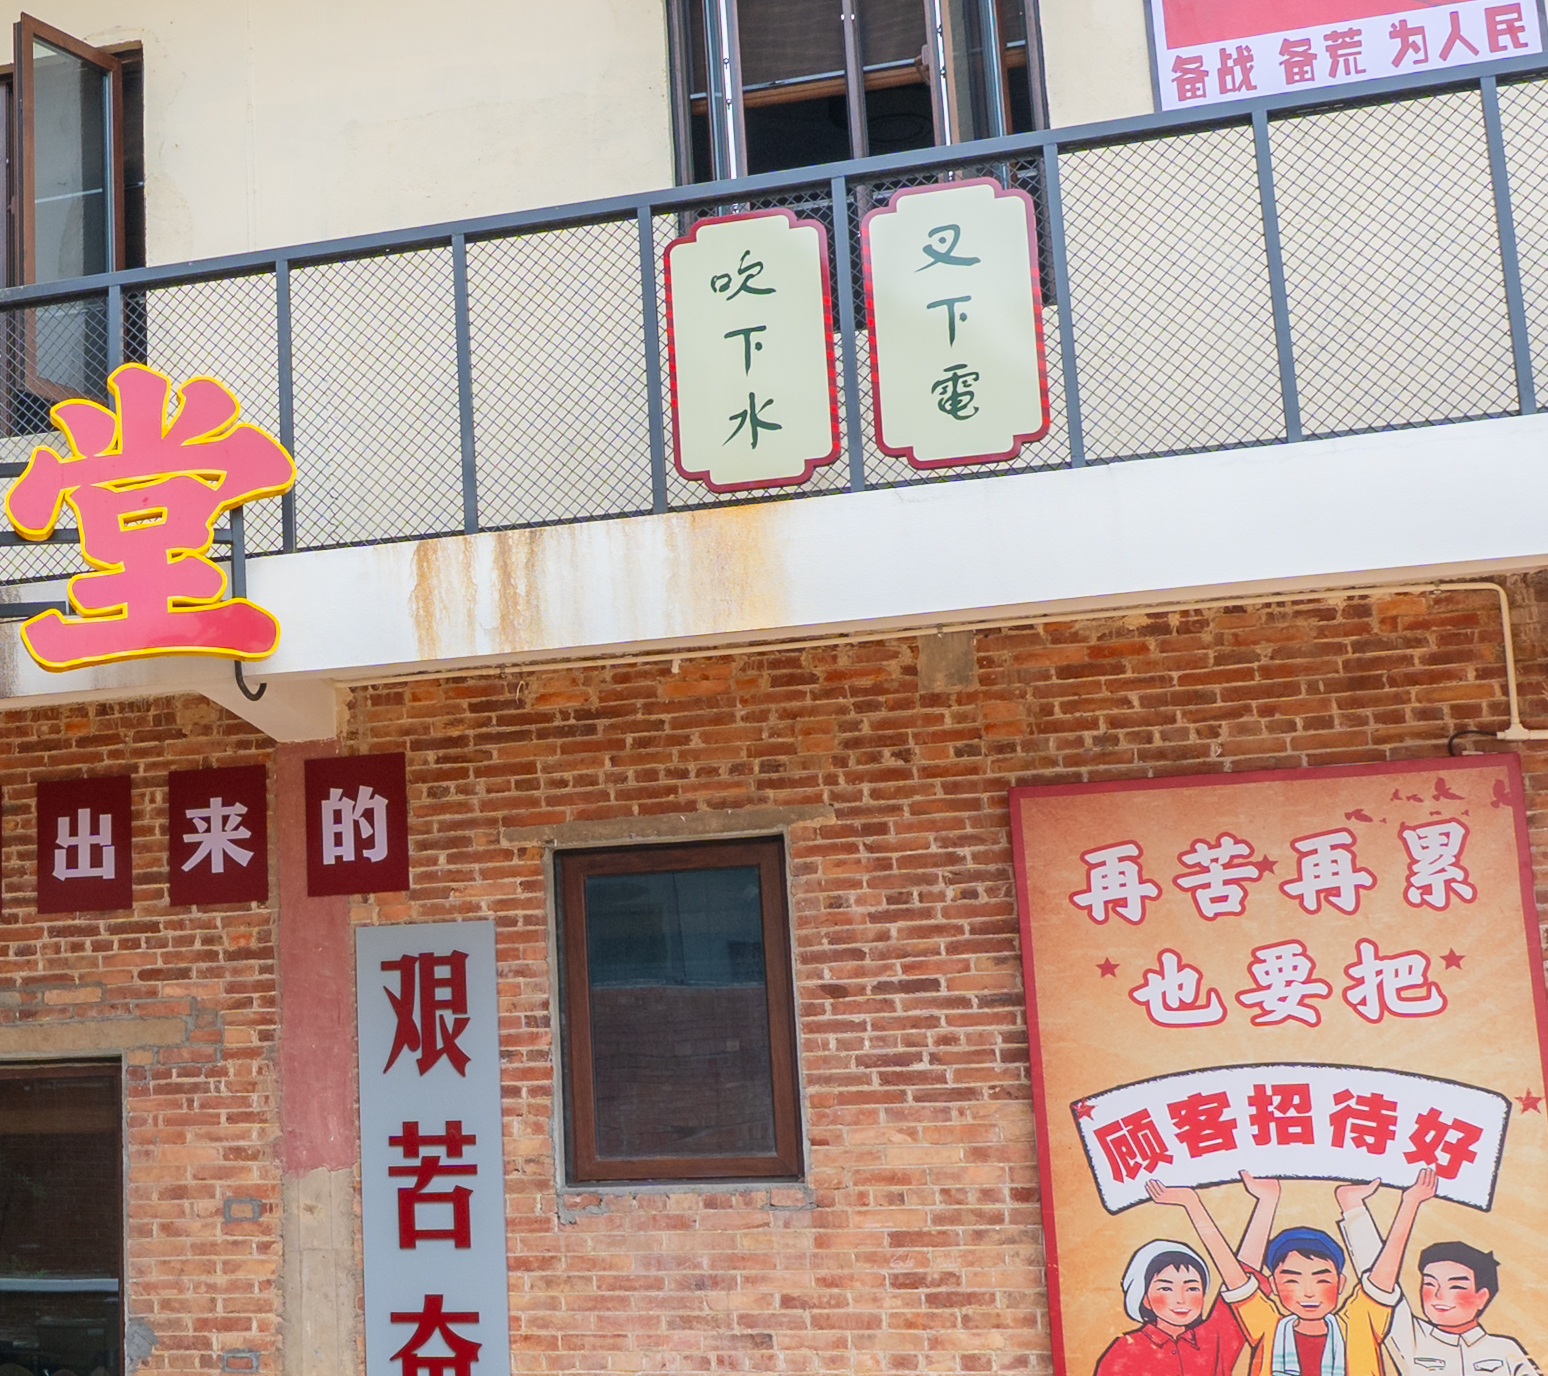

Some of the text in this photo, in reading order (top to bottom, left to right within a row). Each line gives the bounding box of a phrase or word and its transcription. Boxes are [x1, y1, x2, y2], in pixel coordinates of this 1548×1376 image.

[1171, 2, 1530, 103] 备战 备荒 为人民
[710, 249, 784, 450] 吹下水
[1071, 820, 1476, 924] 再苦再累
[1132, 940, 1445, 1026] 也要把
[1092, 1082, 1484, 1184] 顾客招待好
